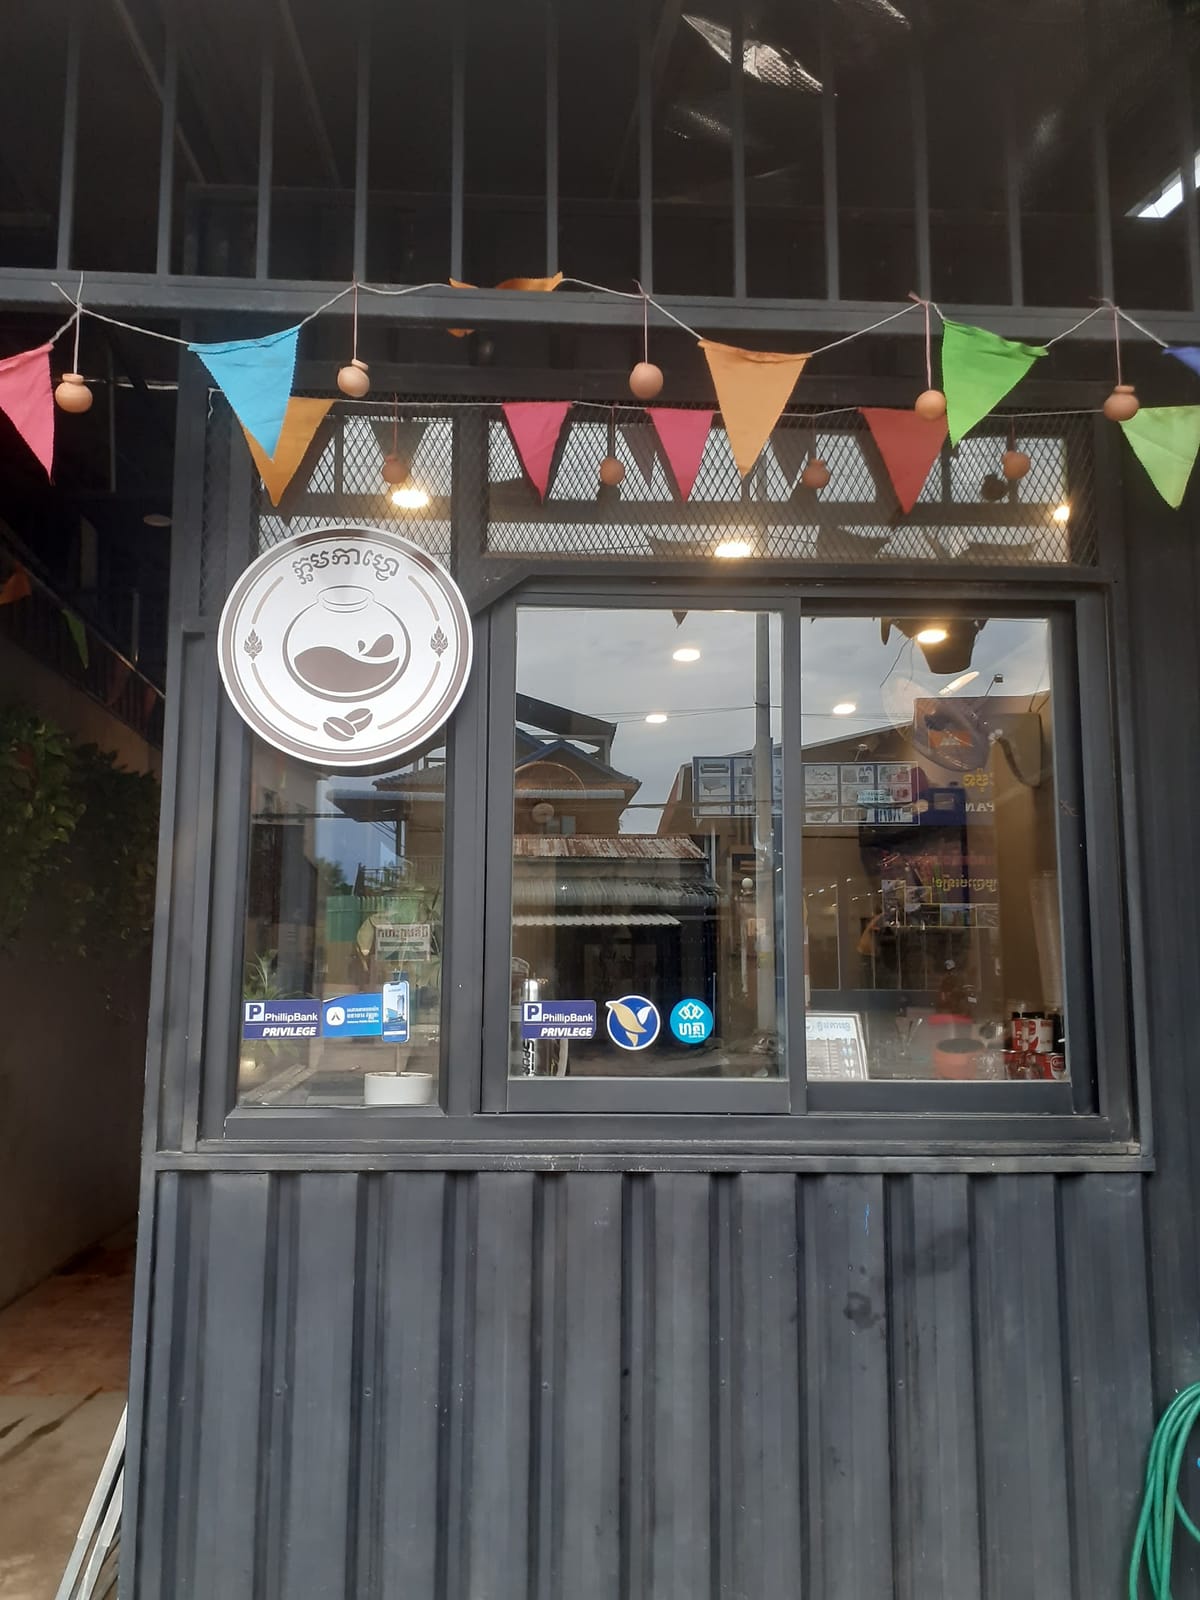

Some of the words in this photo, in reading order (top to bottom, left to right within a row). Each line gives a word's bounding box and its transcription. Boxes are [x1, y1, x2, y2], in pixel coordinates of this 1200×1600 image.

[265, 1012, 318, 1023] PhillipBank
[543, 1013, 594, 1024] PhillipBank
[262, 1027, 317, 1037] PRIVILEGE
[540, 1027, 593, 1037] PRIVILEGE
